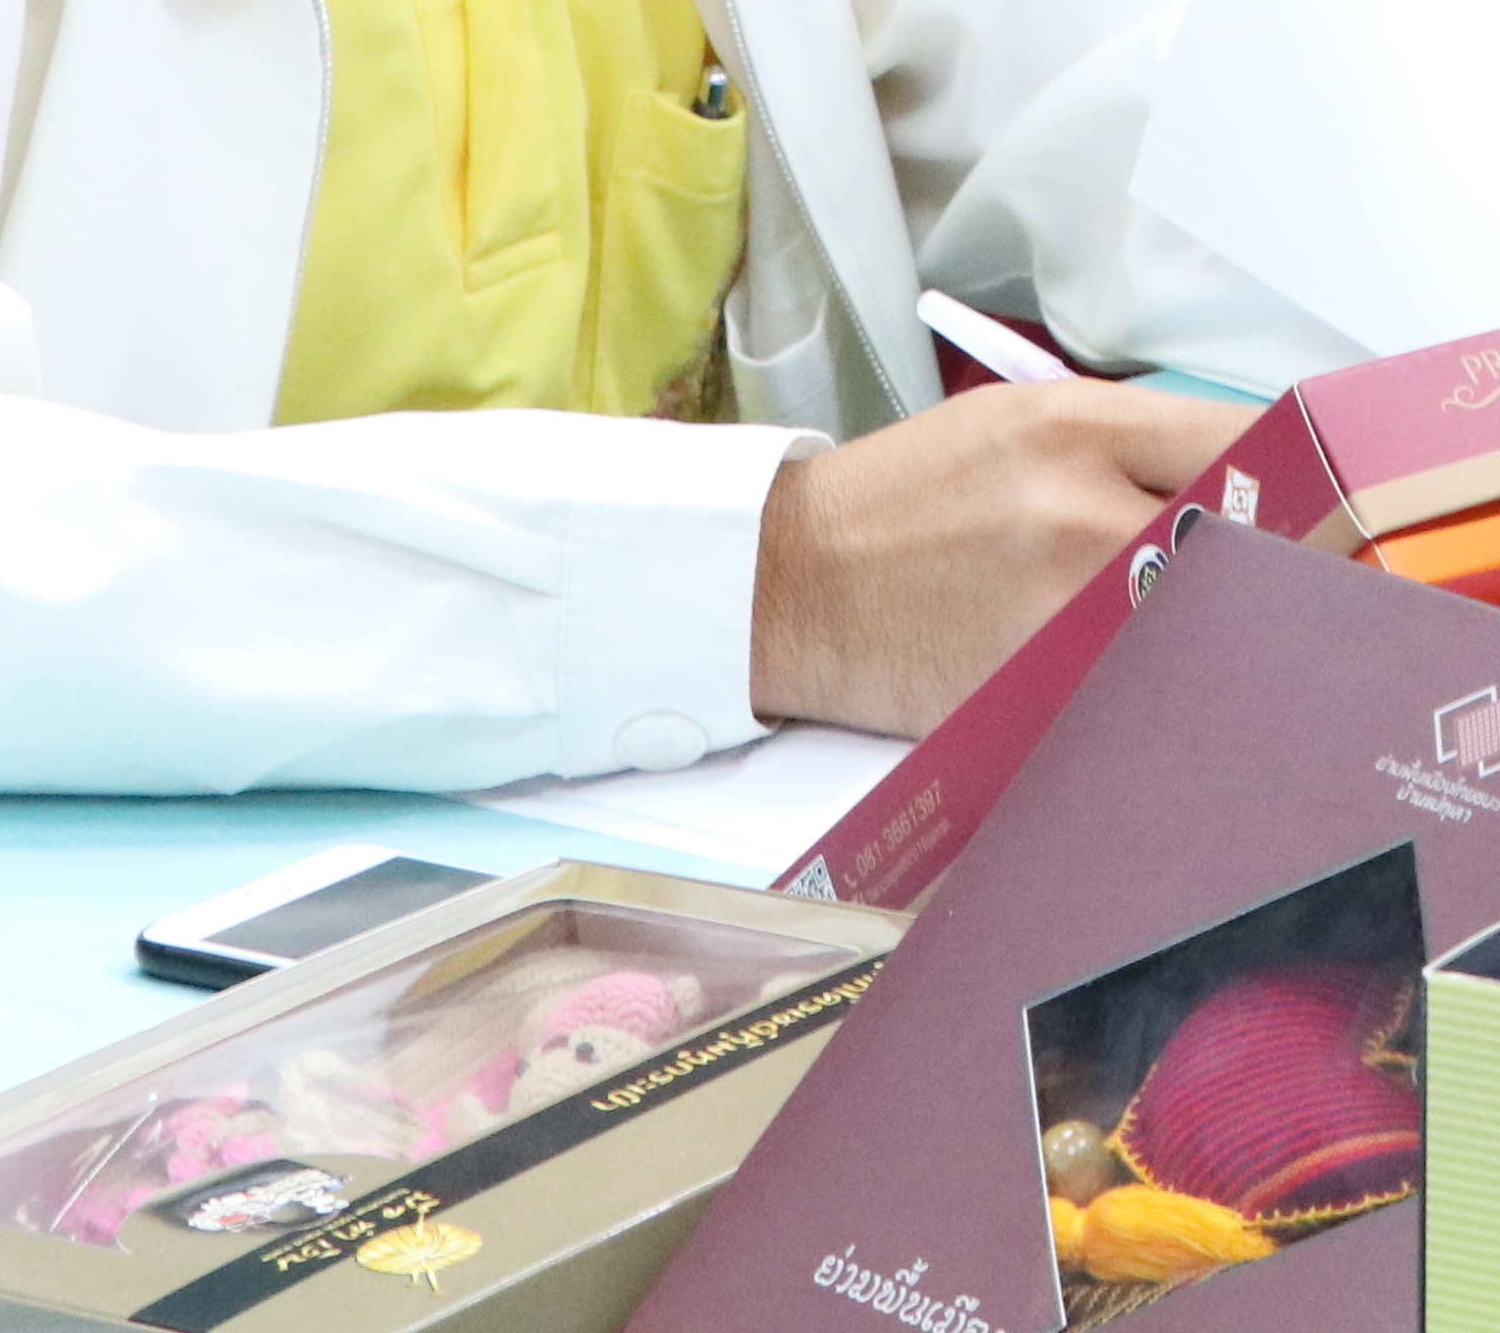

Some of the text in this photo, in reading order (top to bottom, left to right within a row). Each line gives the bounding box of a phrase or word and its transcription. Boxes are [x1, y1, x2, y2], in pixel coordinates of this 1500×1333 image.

[813, 1244, 1007, 1333] ย่ามพื้นเมือ
